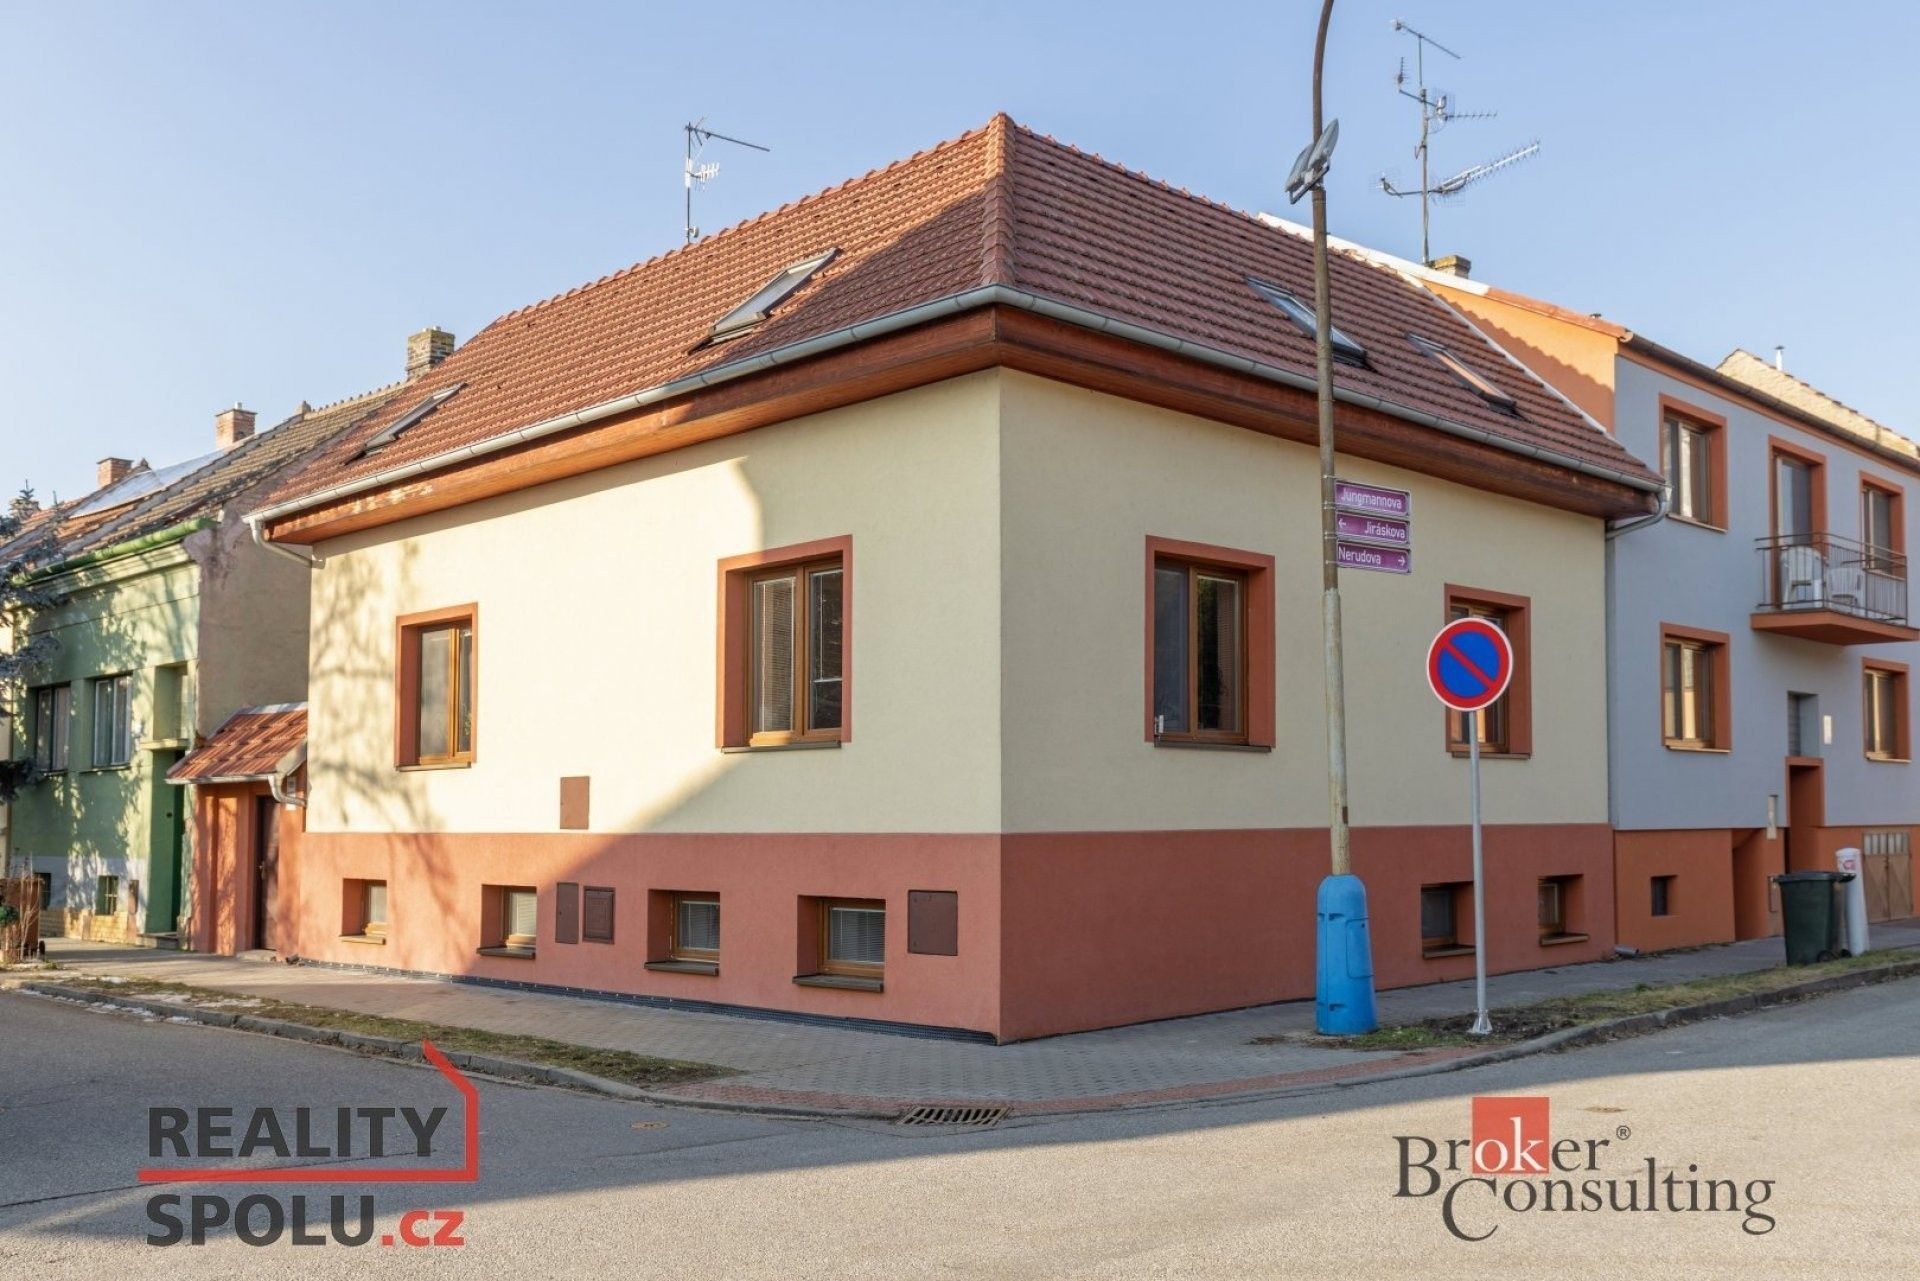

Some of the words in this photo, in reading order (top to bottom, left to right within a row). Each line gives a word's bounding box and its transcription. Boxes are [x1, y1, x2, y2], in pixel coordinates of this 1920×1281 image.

[1341, 488, 1402, 509] Jungmannova
[1365, 522, 1405, 539] Jiráskova
[1339, 546, 1381, 564] Nerudova
